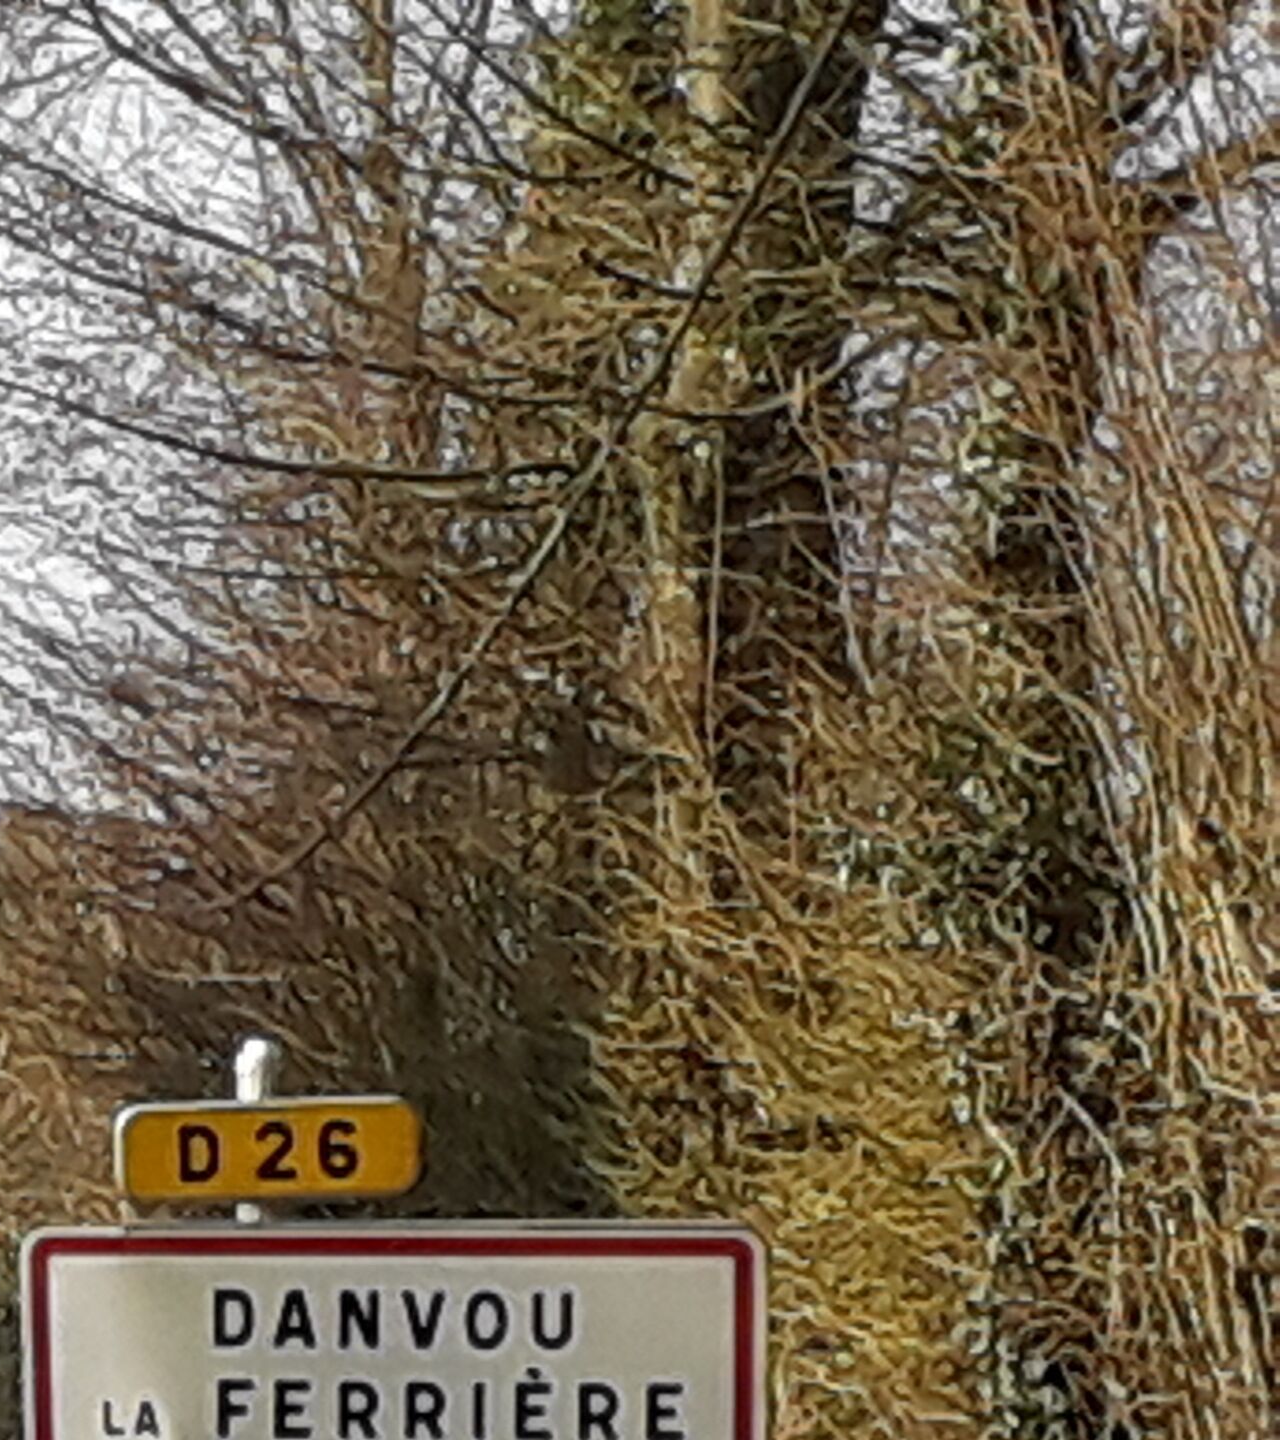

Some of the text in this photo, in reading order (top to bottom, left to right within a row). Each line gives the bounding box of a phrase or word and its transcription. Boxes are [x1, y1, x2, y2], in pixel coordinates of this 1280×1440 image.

[176, 1118, 360, 1184] D 26
[212, 1287, 575, 1351] DANVOU
[101, 1399, 161, 1438] LA
